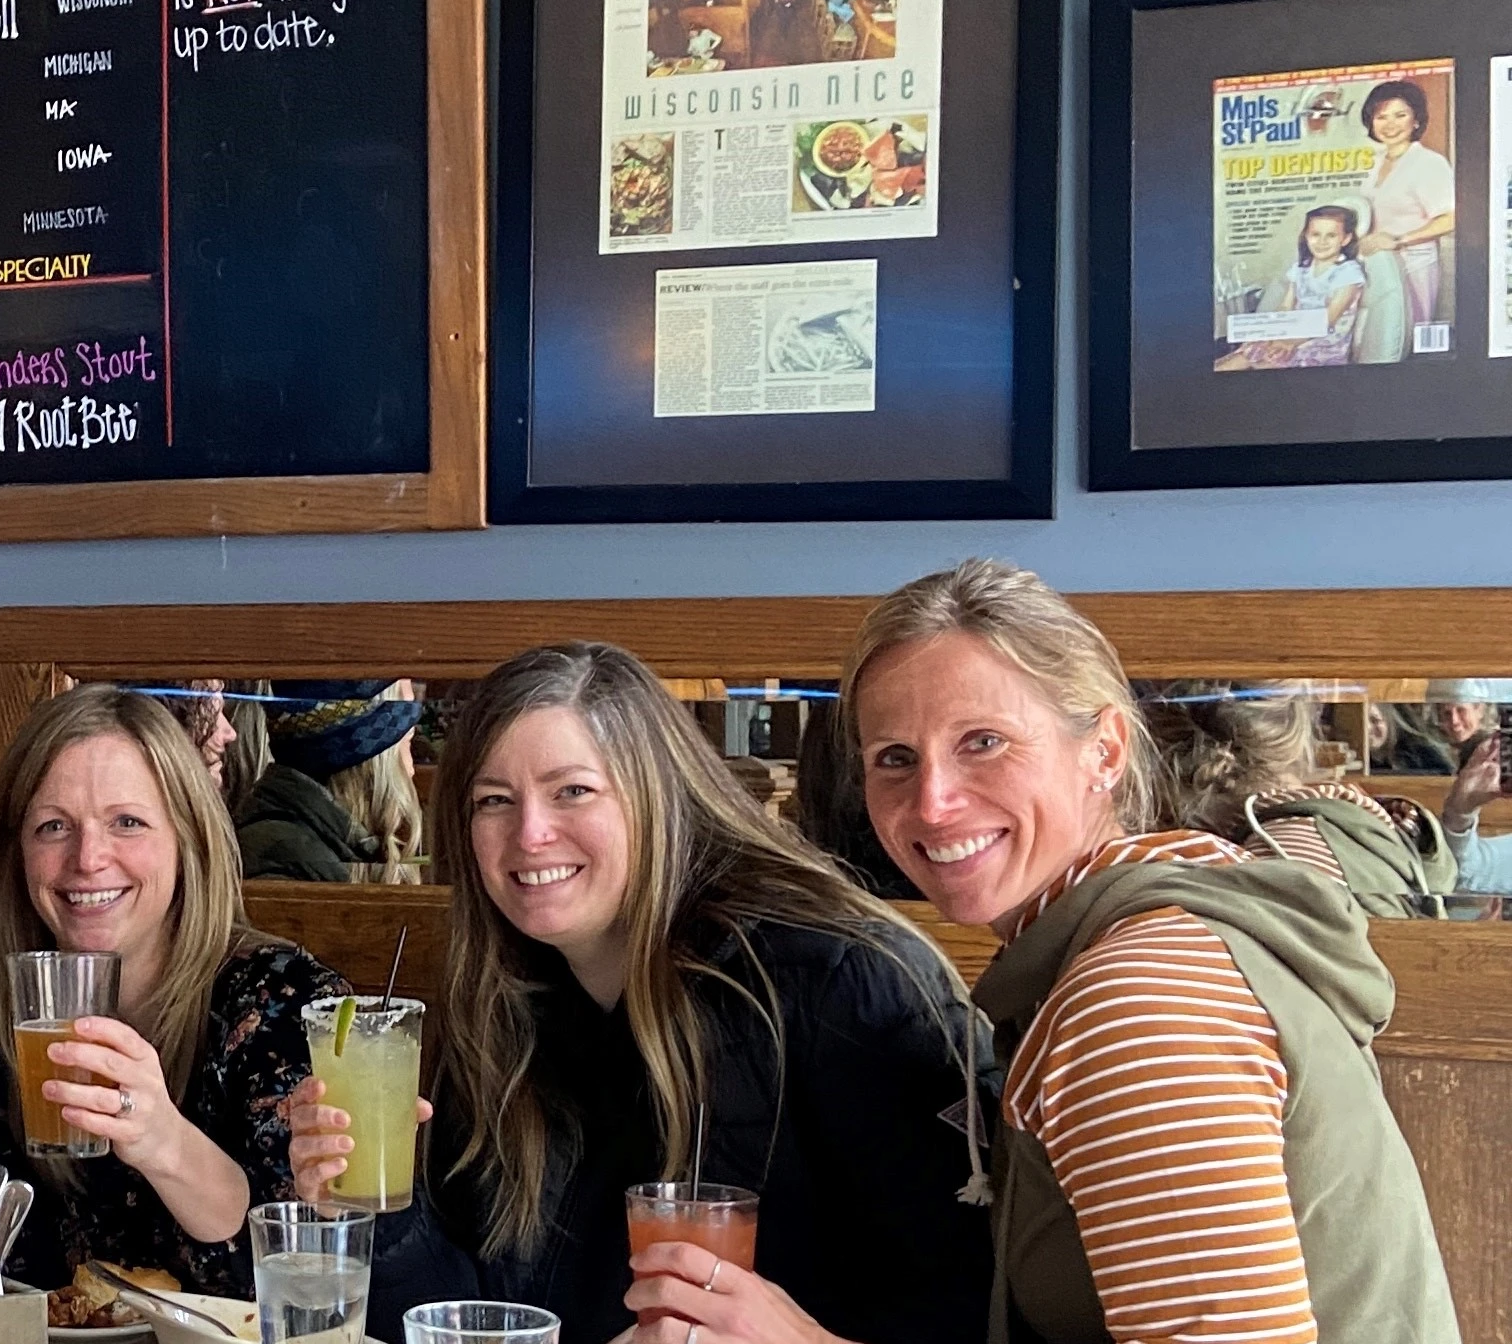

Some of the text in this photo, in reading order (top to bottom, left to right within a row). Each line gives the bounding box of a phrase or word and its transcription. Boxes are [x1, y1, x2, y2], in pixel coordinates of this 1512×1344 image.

[173, 10, 335, 72] up to date.
[44, 50, 112, 78] MICHIGAN
[624, 66, 914, 120] wisconsin nice
[46, 99, 78, 121] MA
[1222, 95, 1278, 129] Mpls
[57, 143, 112, 172] IOWA
[1223, 147, 1375, 180] TOP DENTISTS
[23, 206, 109, 234] MINNESOTA
[76, 336, 156, 386] Stout
[13, 395, 77, 452] Root
[78, 395, 139, 449] Bee
